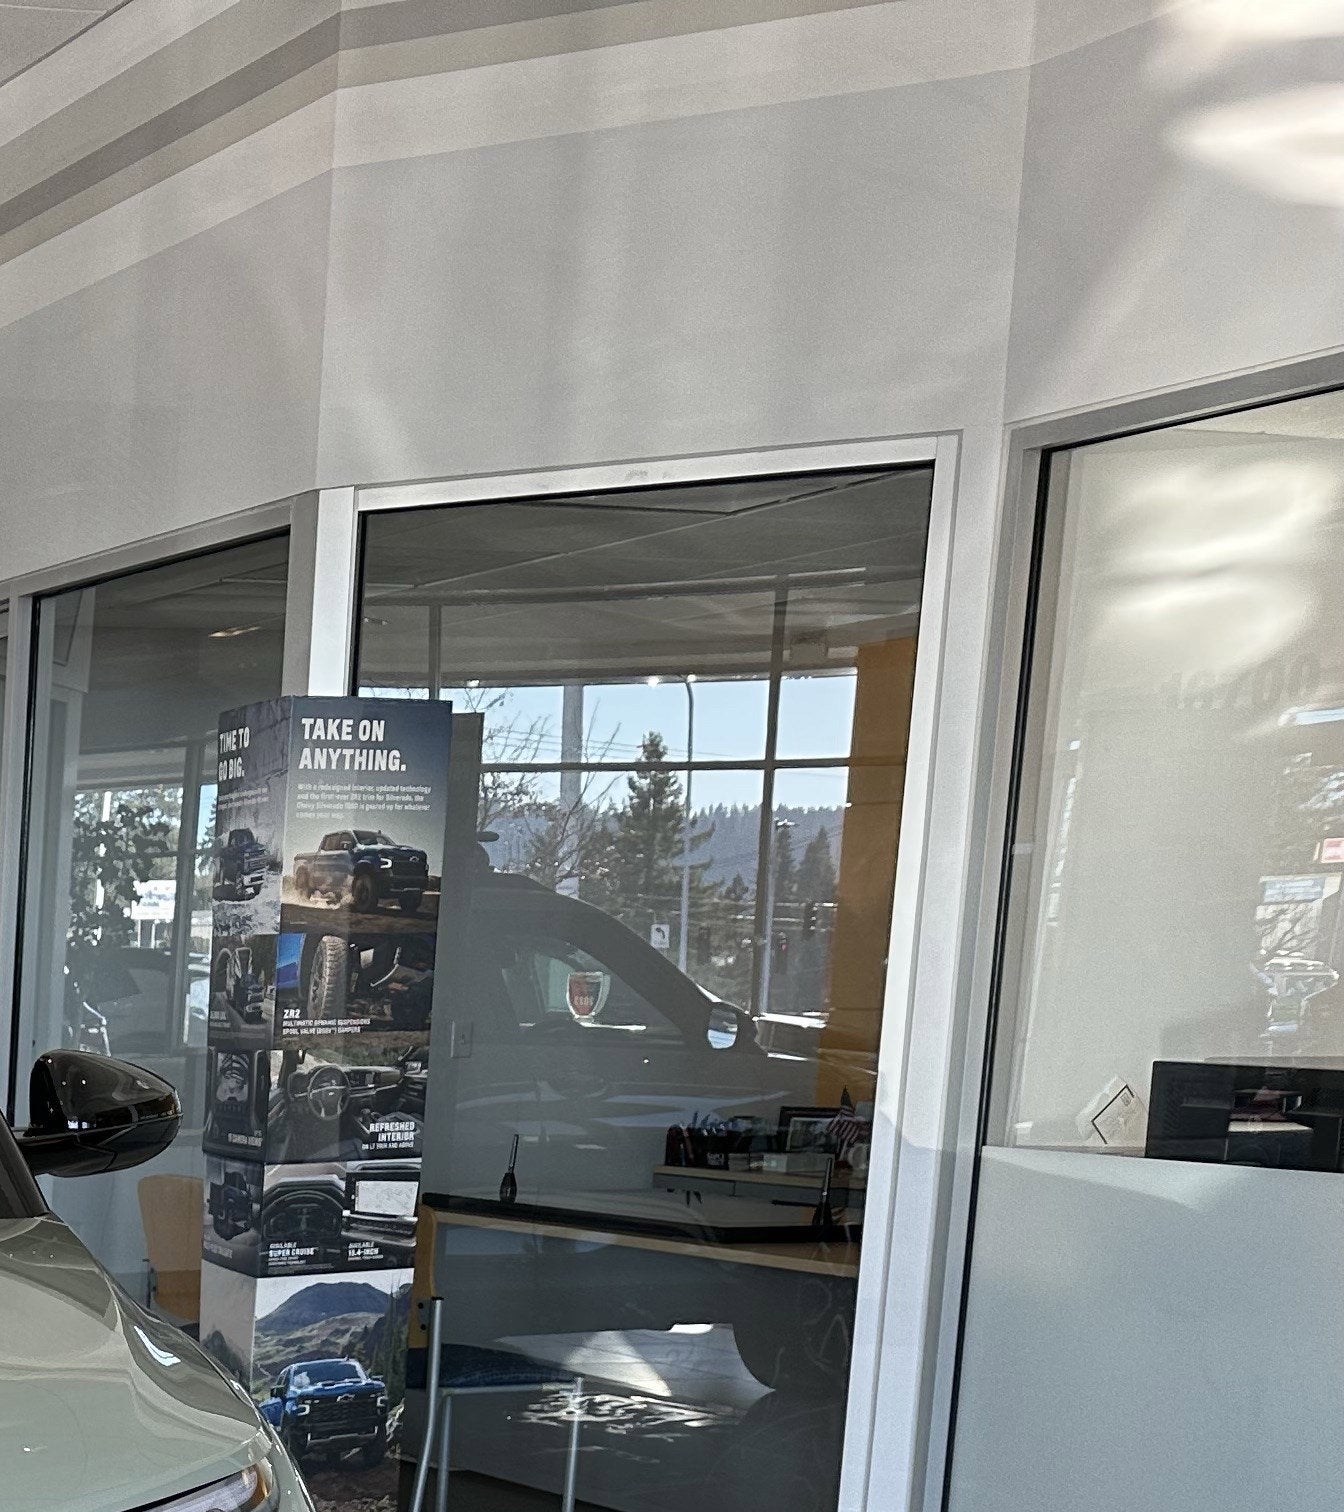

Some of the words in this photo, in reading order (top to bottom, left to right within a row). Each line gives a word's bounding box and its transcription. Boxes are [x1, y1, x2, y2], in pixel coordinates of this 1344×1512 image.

[238, 726, 250, 749] TO
[301, 718, 353, 741] TAKE
[358, 720, 385, 742] ON
[228, 756, 245, 780] BIG.
[298, 748, 407, 772] ANYTHING.
[283, 1008, 301, 1019] ZR2
[369, 1121, 415, 1133] REFRESHED
[377, 1132, 414, 1142] INTERIOR
